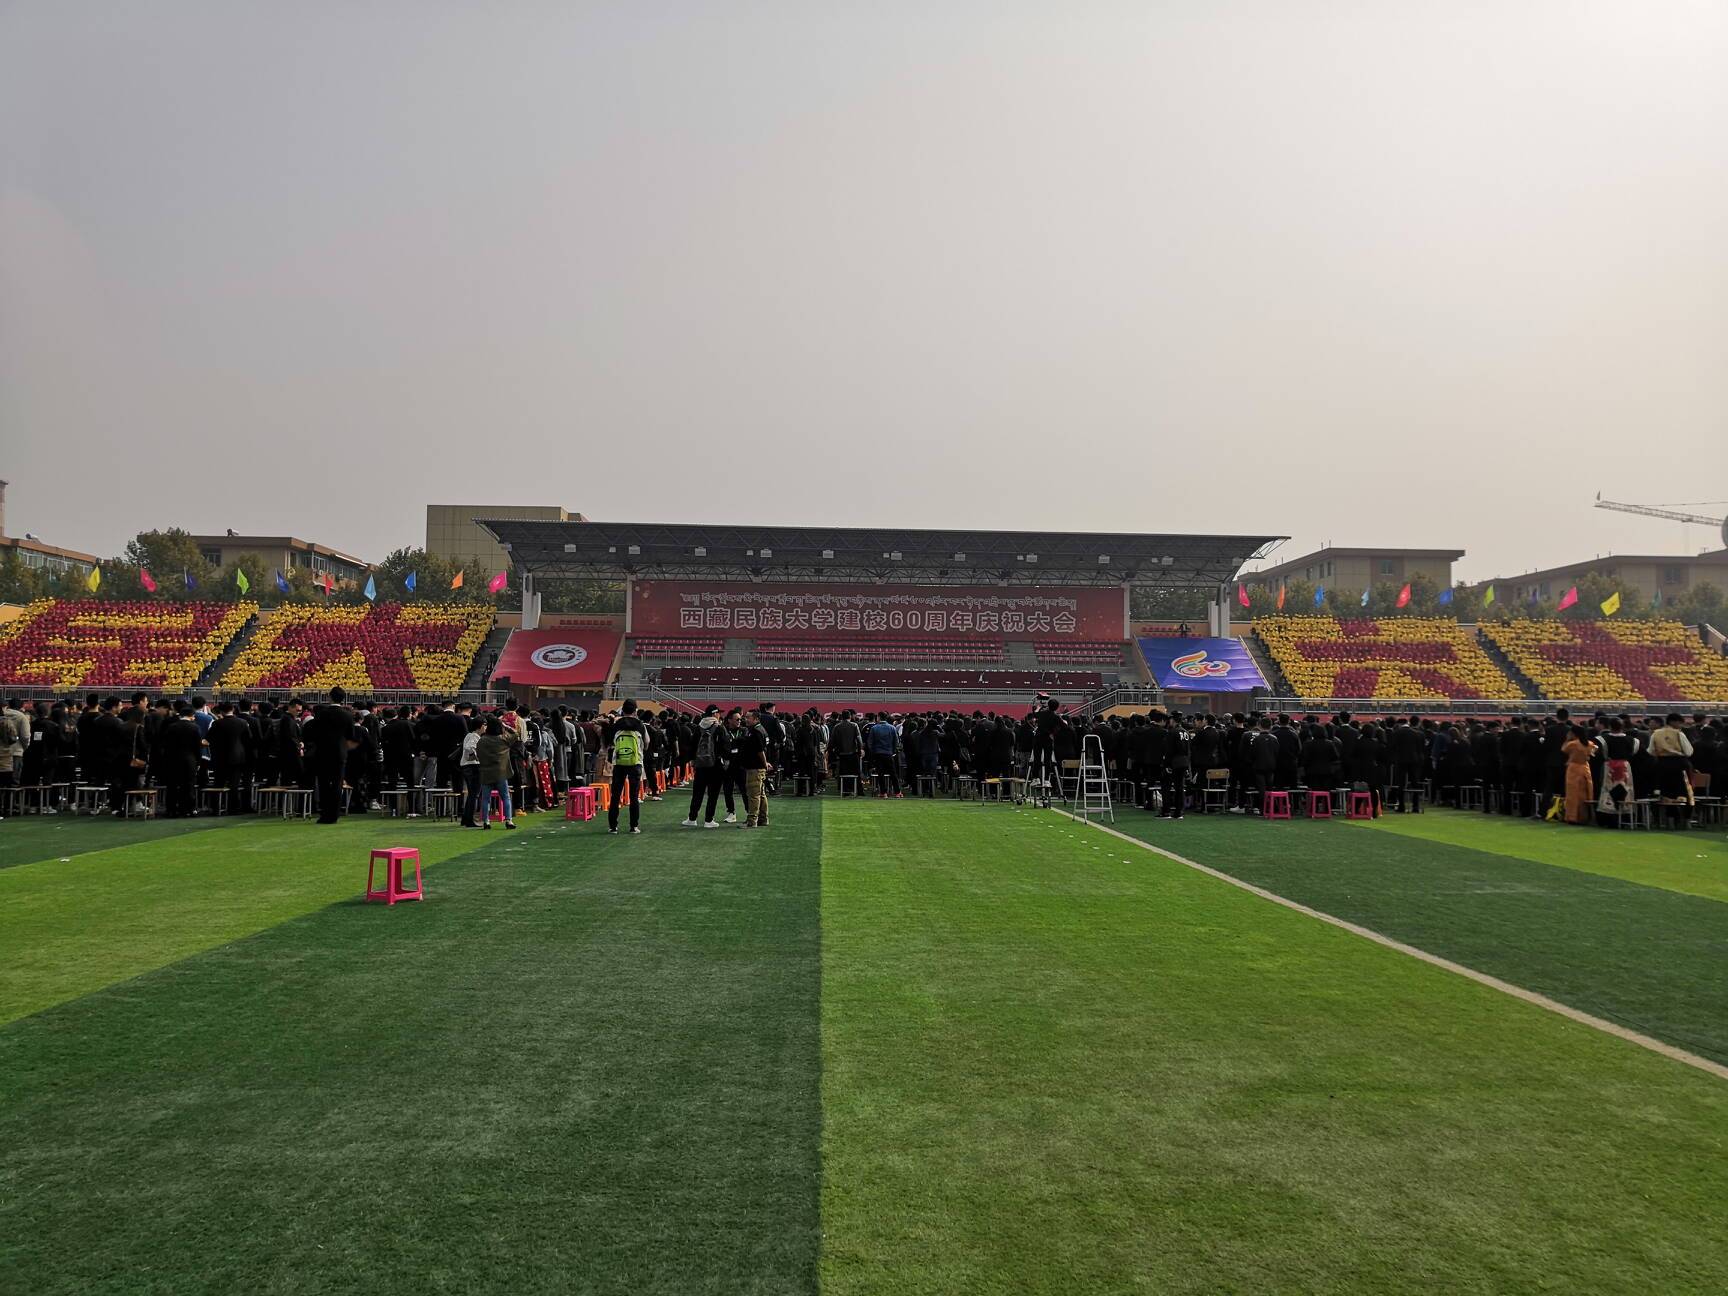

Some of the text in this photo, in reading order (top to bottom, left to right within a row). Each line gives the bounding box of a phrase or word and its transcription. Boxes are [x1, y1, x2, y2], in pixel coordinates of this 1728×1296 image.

[680, 607, 1077, 632] 西藏民族大学建校60周年庆祝大会
